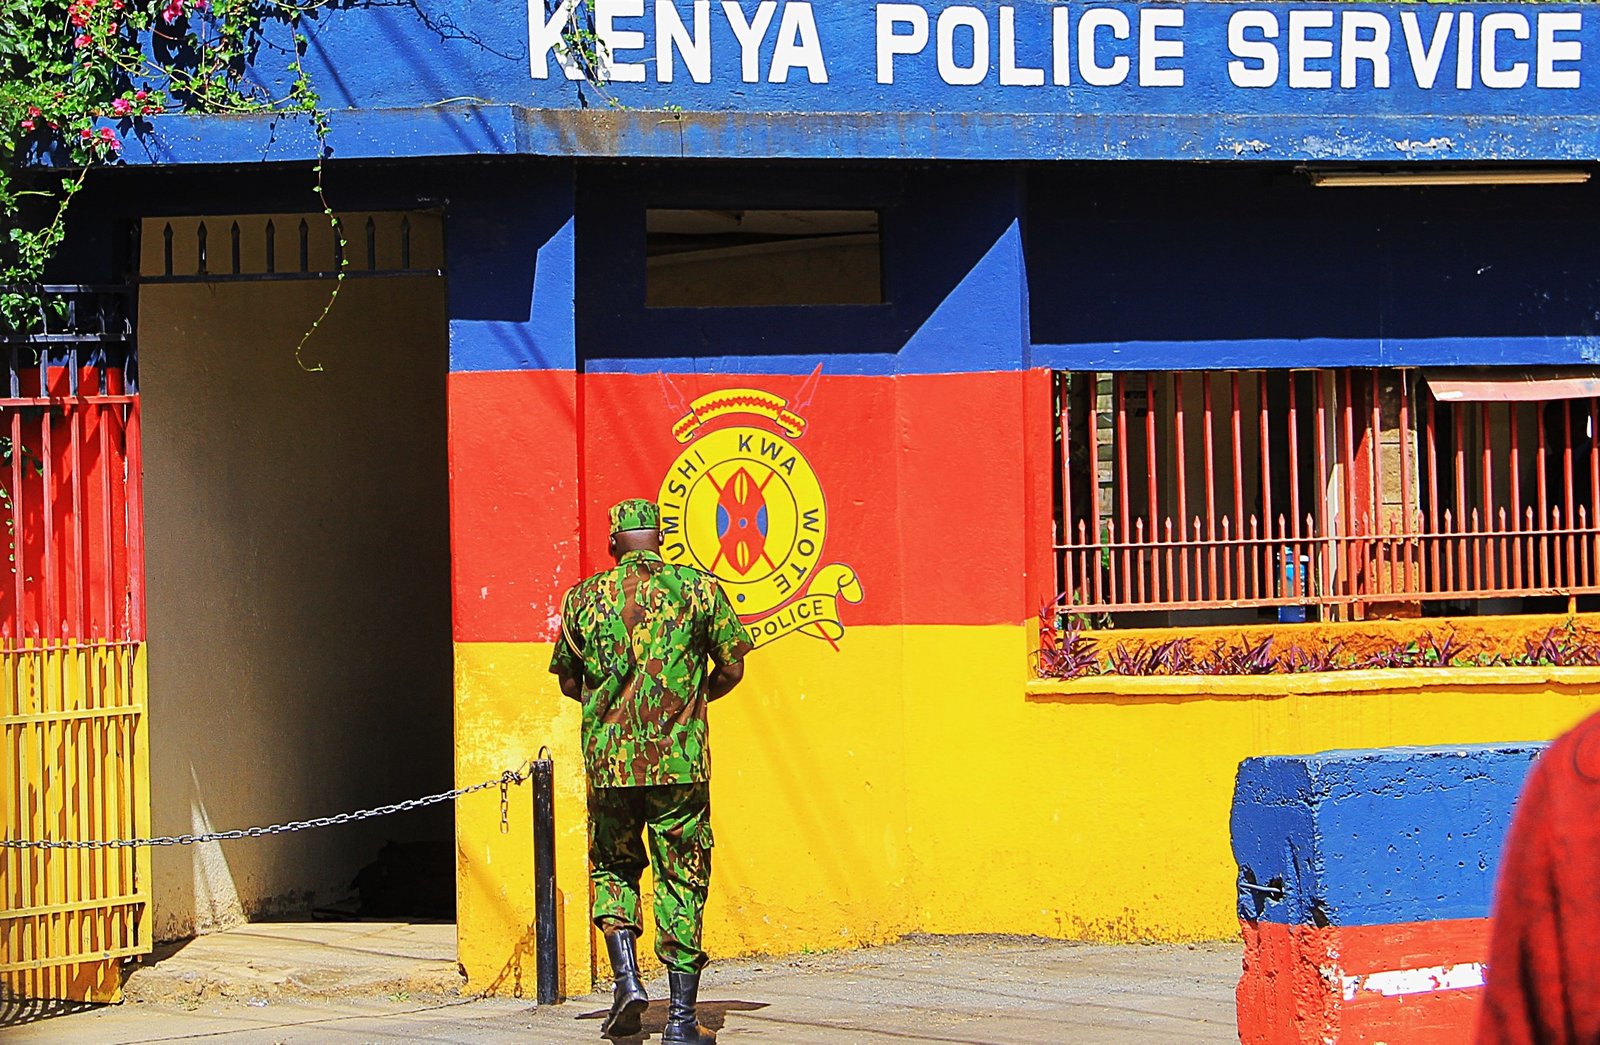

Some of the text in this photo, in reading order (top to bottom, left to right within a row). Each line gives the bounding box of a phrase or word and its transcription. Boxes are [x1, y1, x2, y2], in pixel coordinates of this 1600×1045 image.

[528, 0, 1583, 90] KENYA POLICE SERVICE
[662, 434, 820, 595] UMISHI KWA WOTE
[750, 600, 823, 642] POLICE
